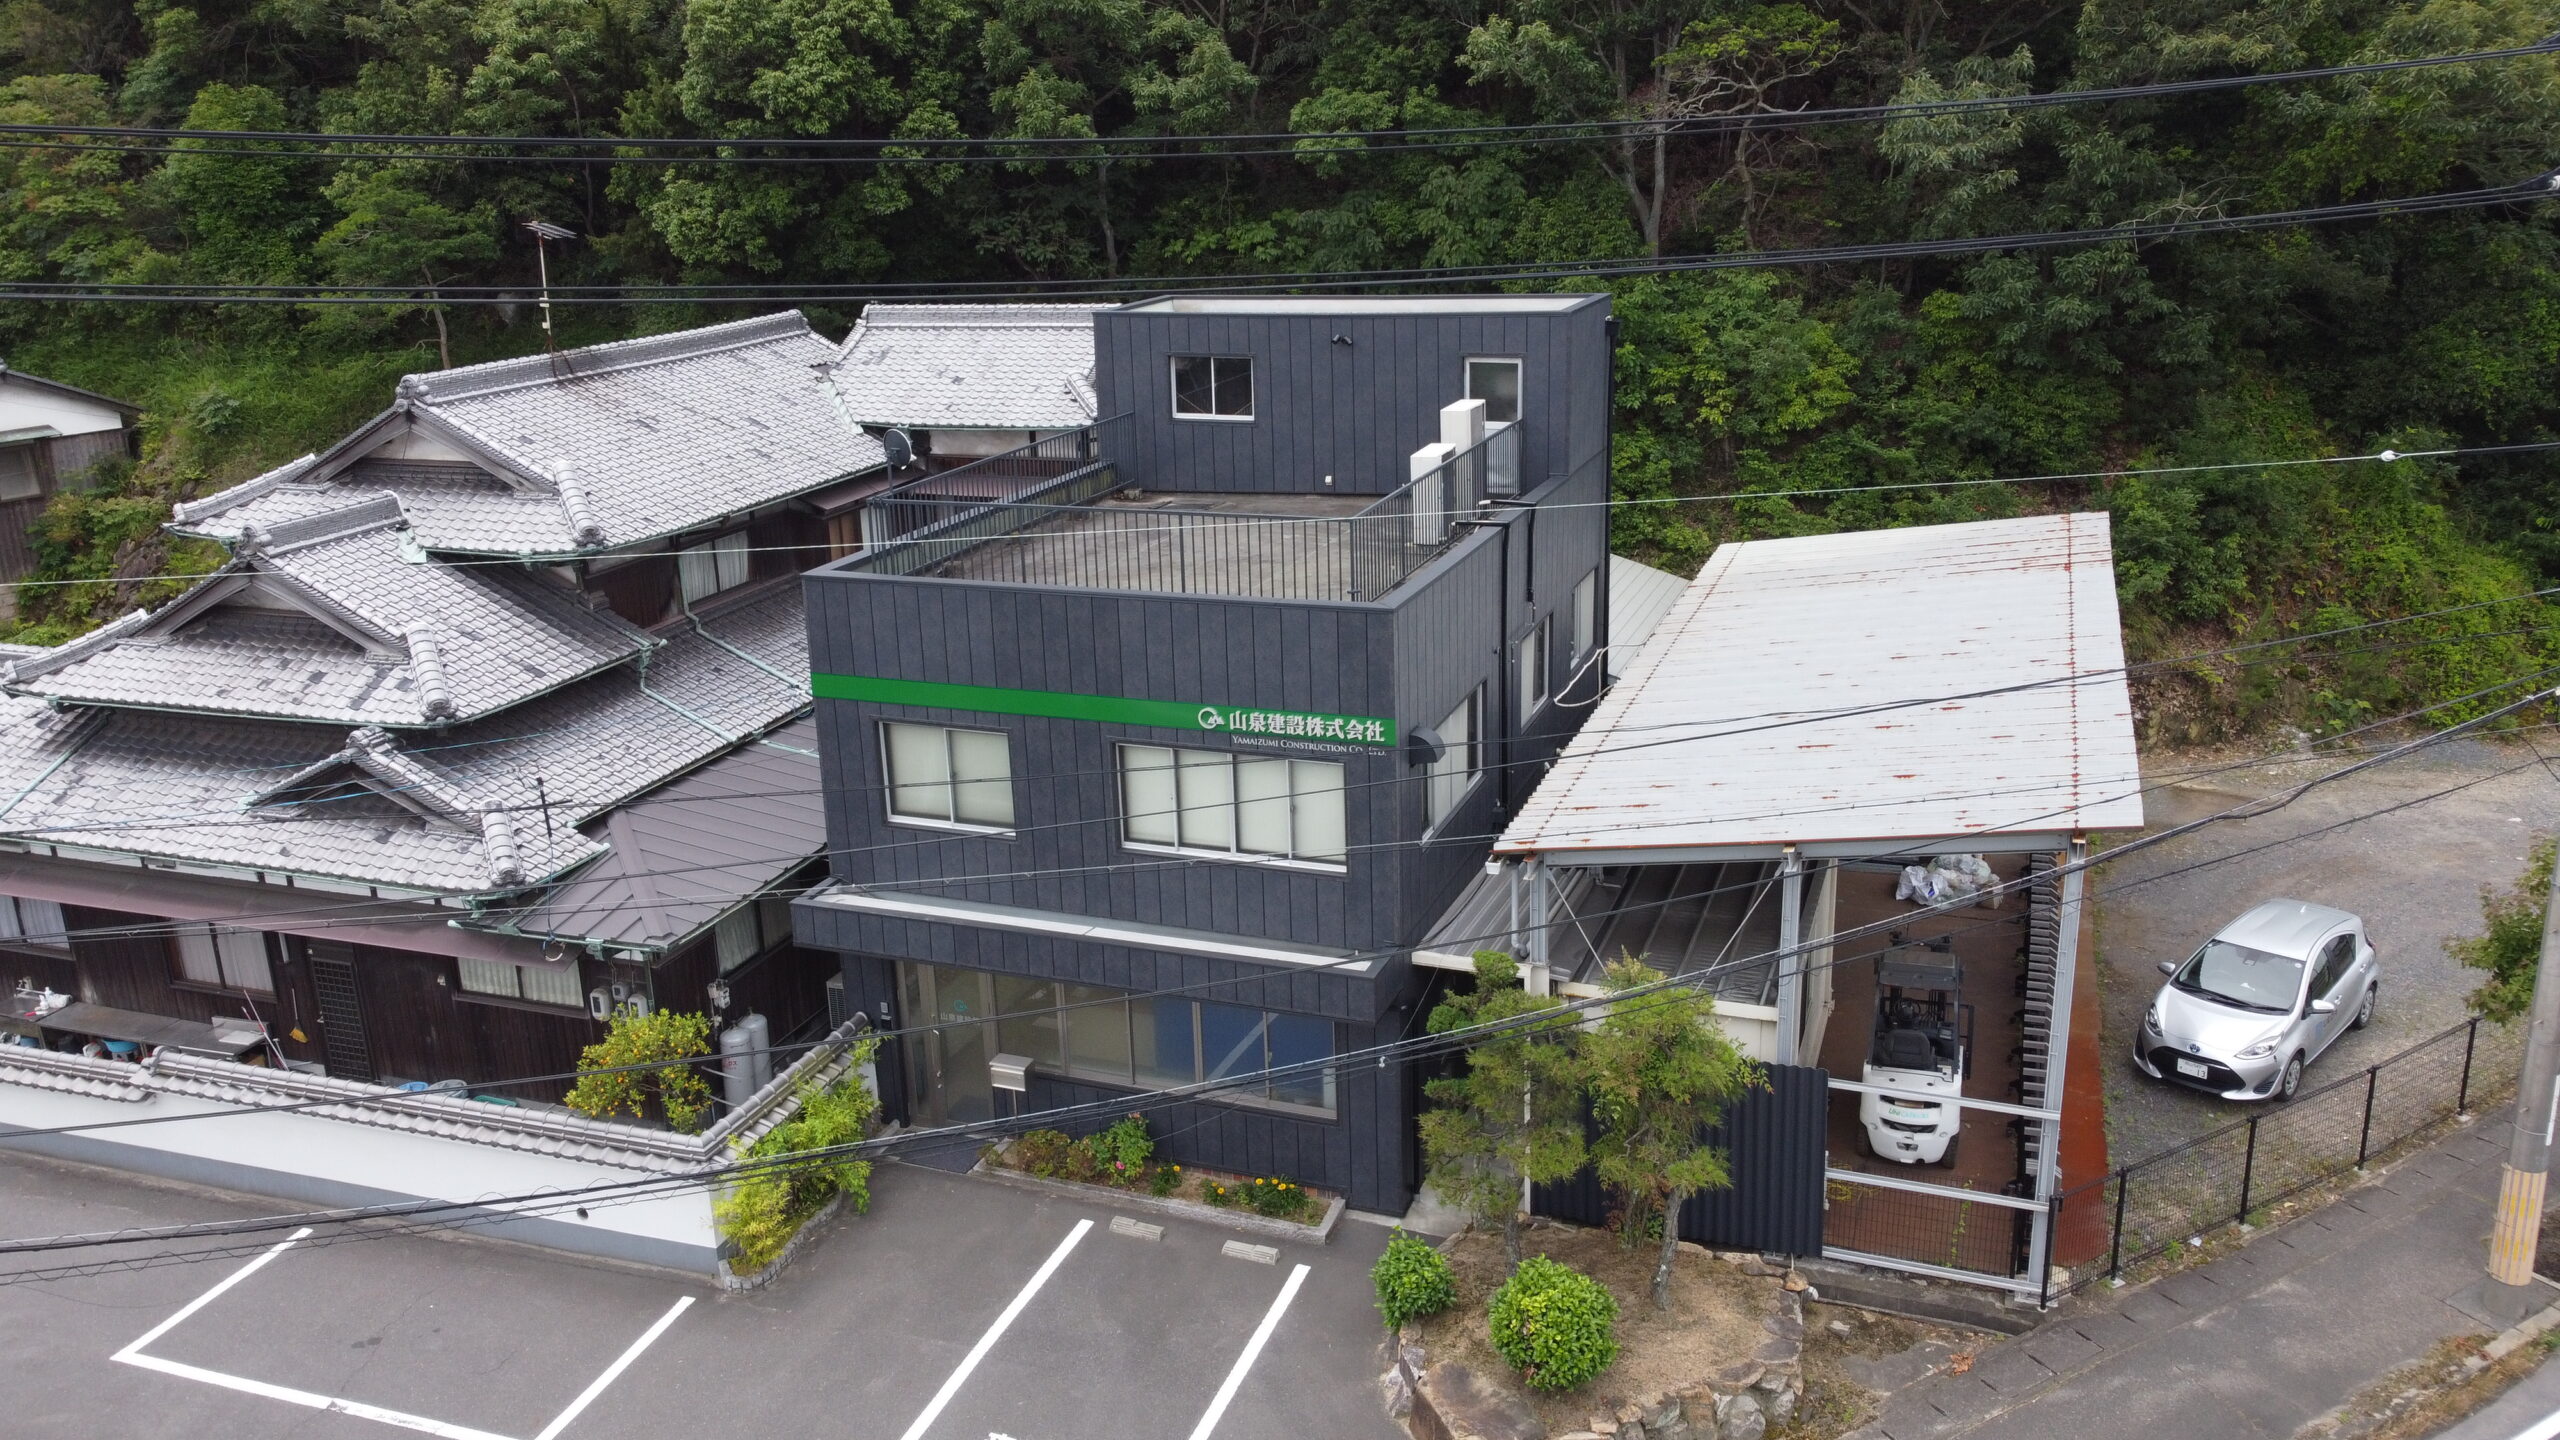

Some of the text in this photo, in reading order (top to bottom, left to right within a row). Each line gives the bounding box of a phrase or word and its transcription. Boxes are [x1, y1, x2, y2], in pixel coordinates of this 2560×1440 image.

[1229, 710, 1385, 742] 山泉建設株式会社
[1232, 735, 1279, 747] YAMAIZUMI
[1280, 739, 1347, 753] CONSTRUCTION
